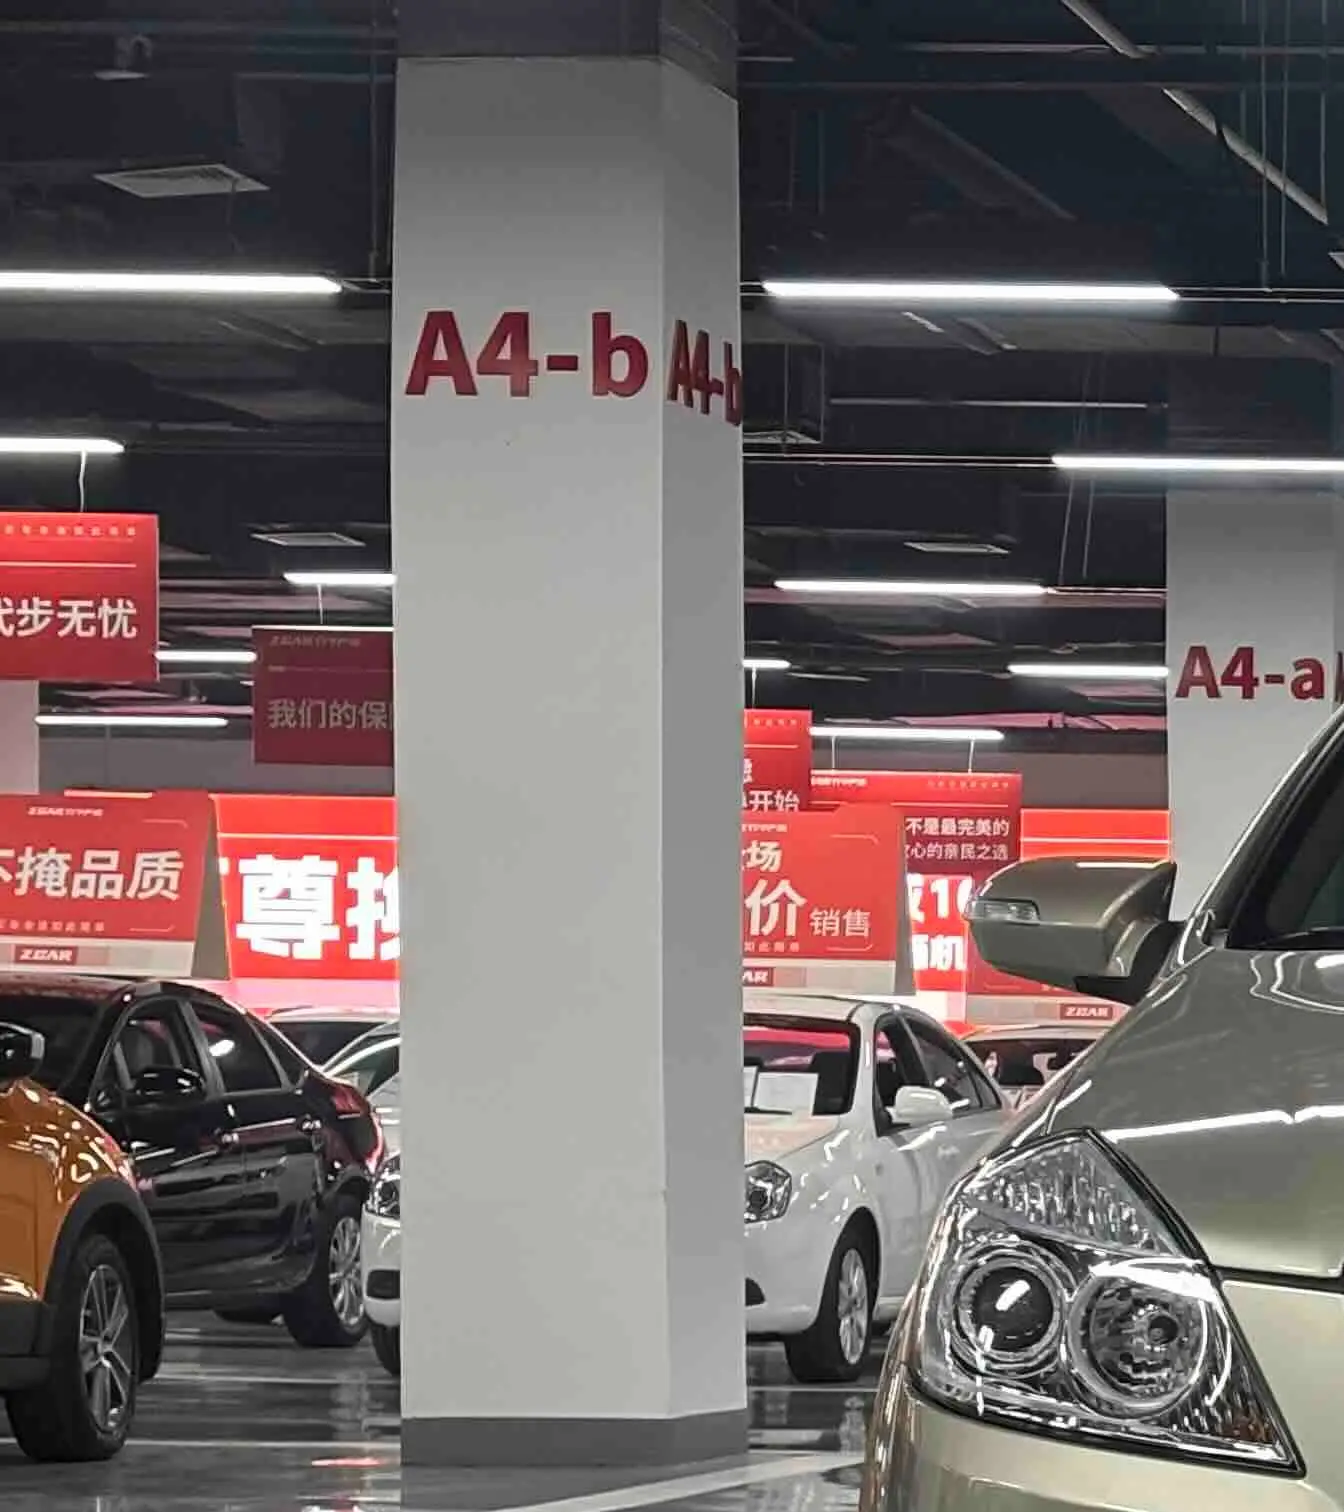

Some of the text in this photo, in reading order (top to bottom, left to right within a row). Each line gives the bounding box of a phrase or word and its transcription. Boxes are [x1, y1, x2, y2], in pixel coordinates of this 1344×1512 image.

[405, 311, 649, 397] A4-b
[667, 319, 743, 427] A4-b
[1175, 645, 1326, 700] A4-a
[268, 699, 393, 730] 我们的保
[743, 789, 800, 812] 开始
